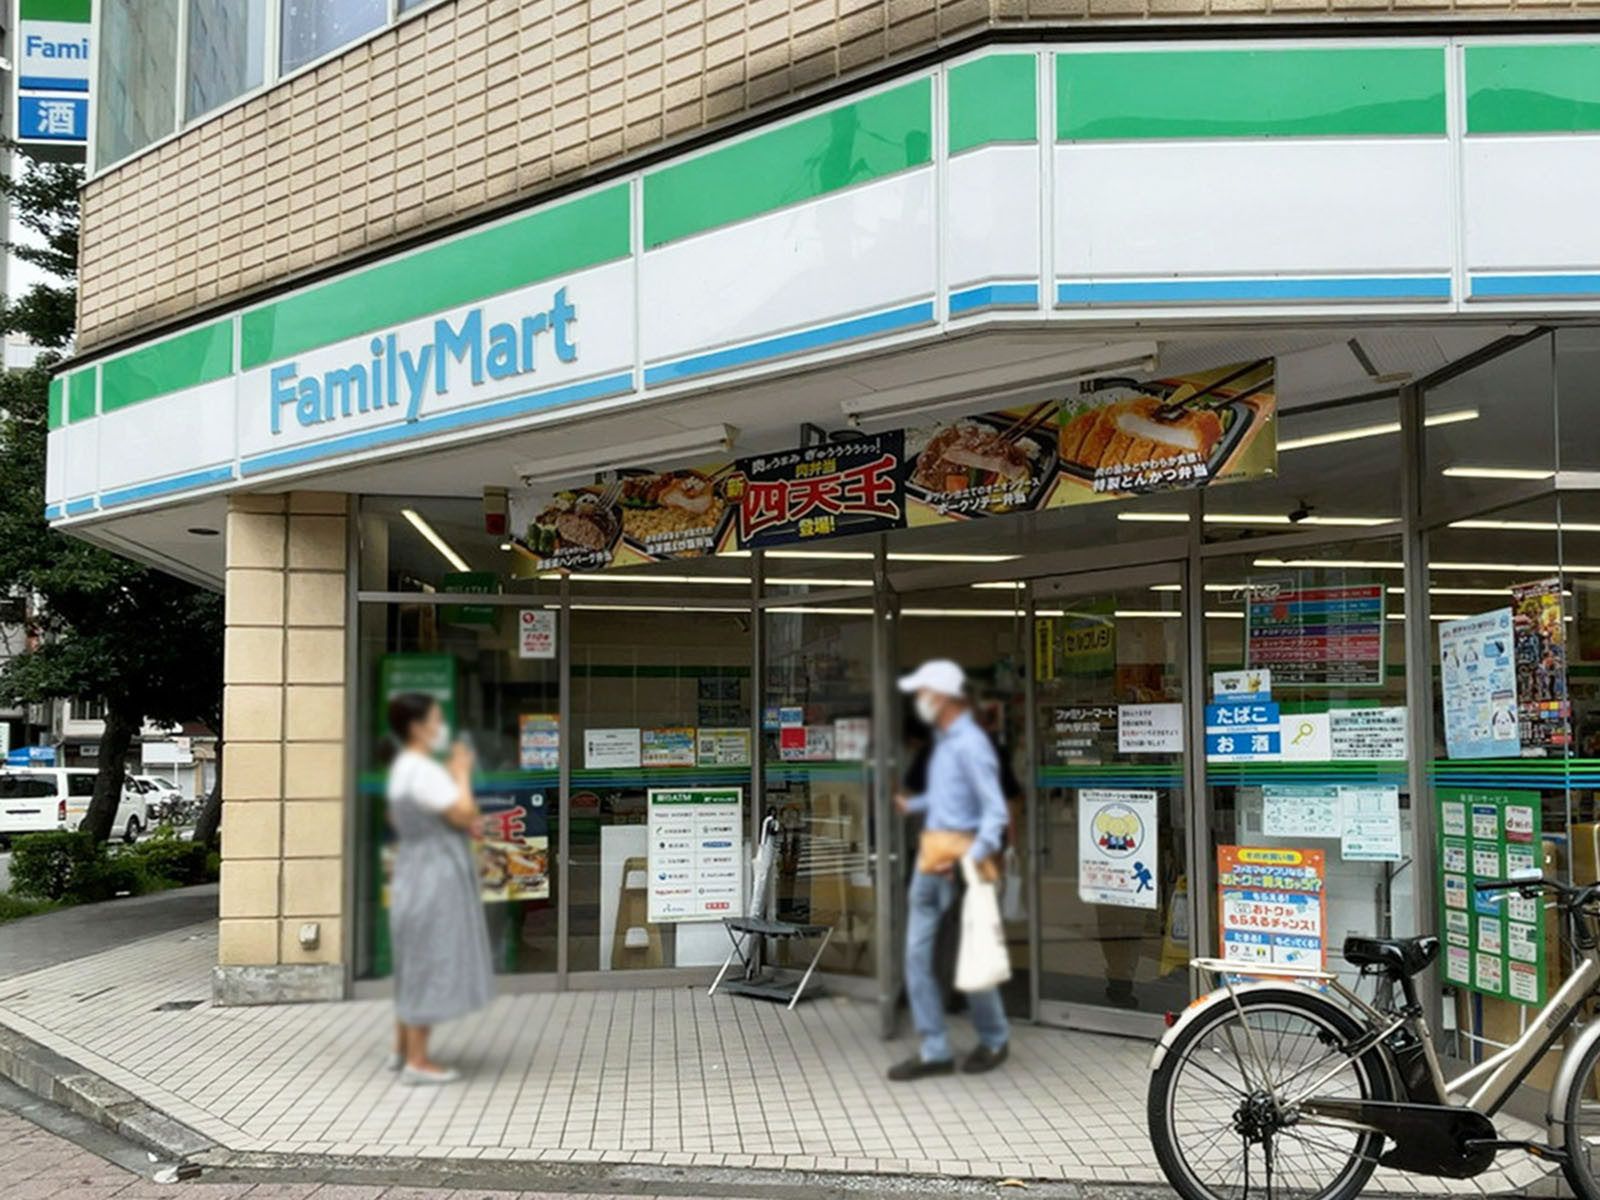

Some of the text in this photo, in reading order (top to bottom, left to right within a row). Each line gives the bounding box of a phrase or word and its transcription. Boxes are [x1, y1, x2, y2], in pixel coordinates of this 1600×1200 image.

[26, 35, 88, 59] Fami
[38, 100, 76, 135] 酒
[270, 285, 578, 434] FamilyMart
[795, 458, 836, 478] 肉弁当
[1094, 464, 1208, 494] 特製とんかつ弁当
[740, 453, 900, 542] 四天王
[799, 515, 836, 537] 登場!
[1055, 707, 1117, 721] ファミリーマート
[1217, 706, 1268, 725] たばこ
[1217, 734, 1269, 753] お酒
[1229, 914, 1316, 931] もらえるチャンス!
